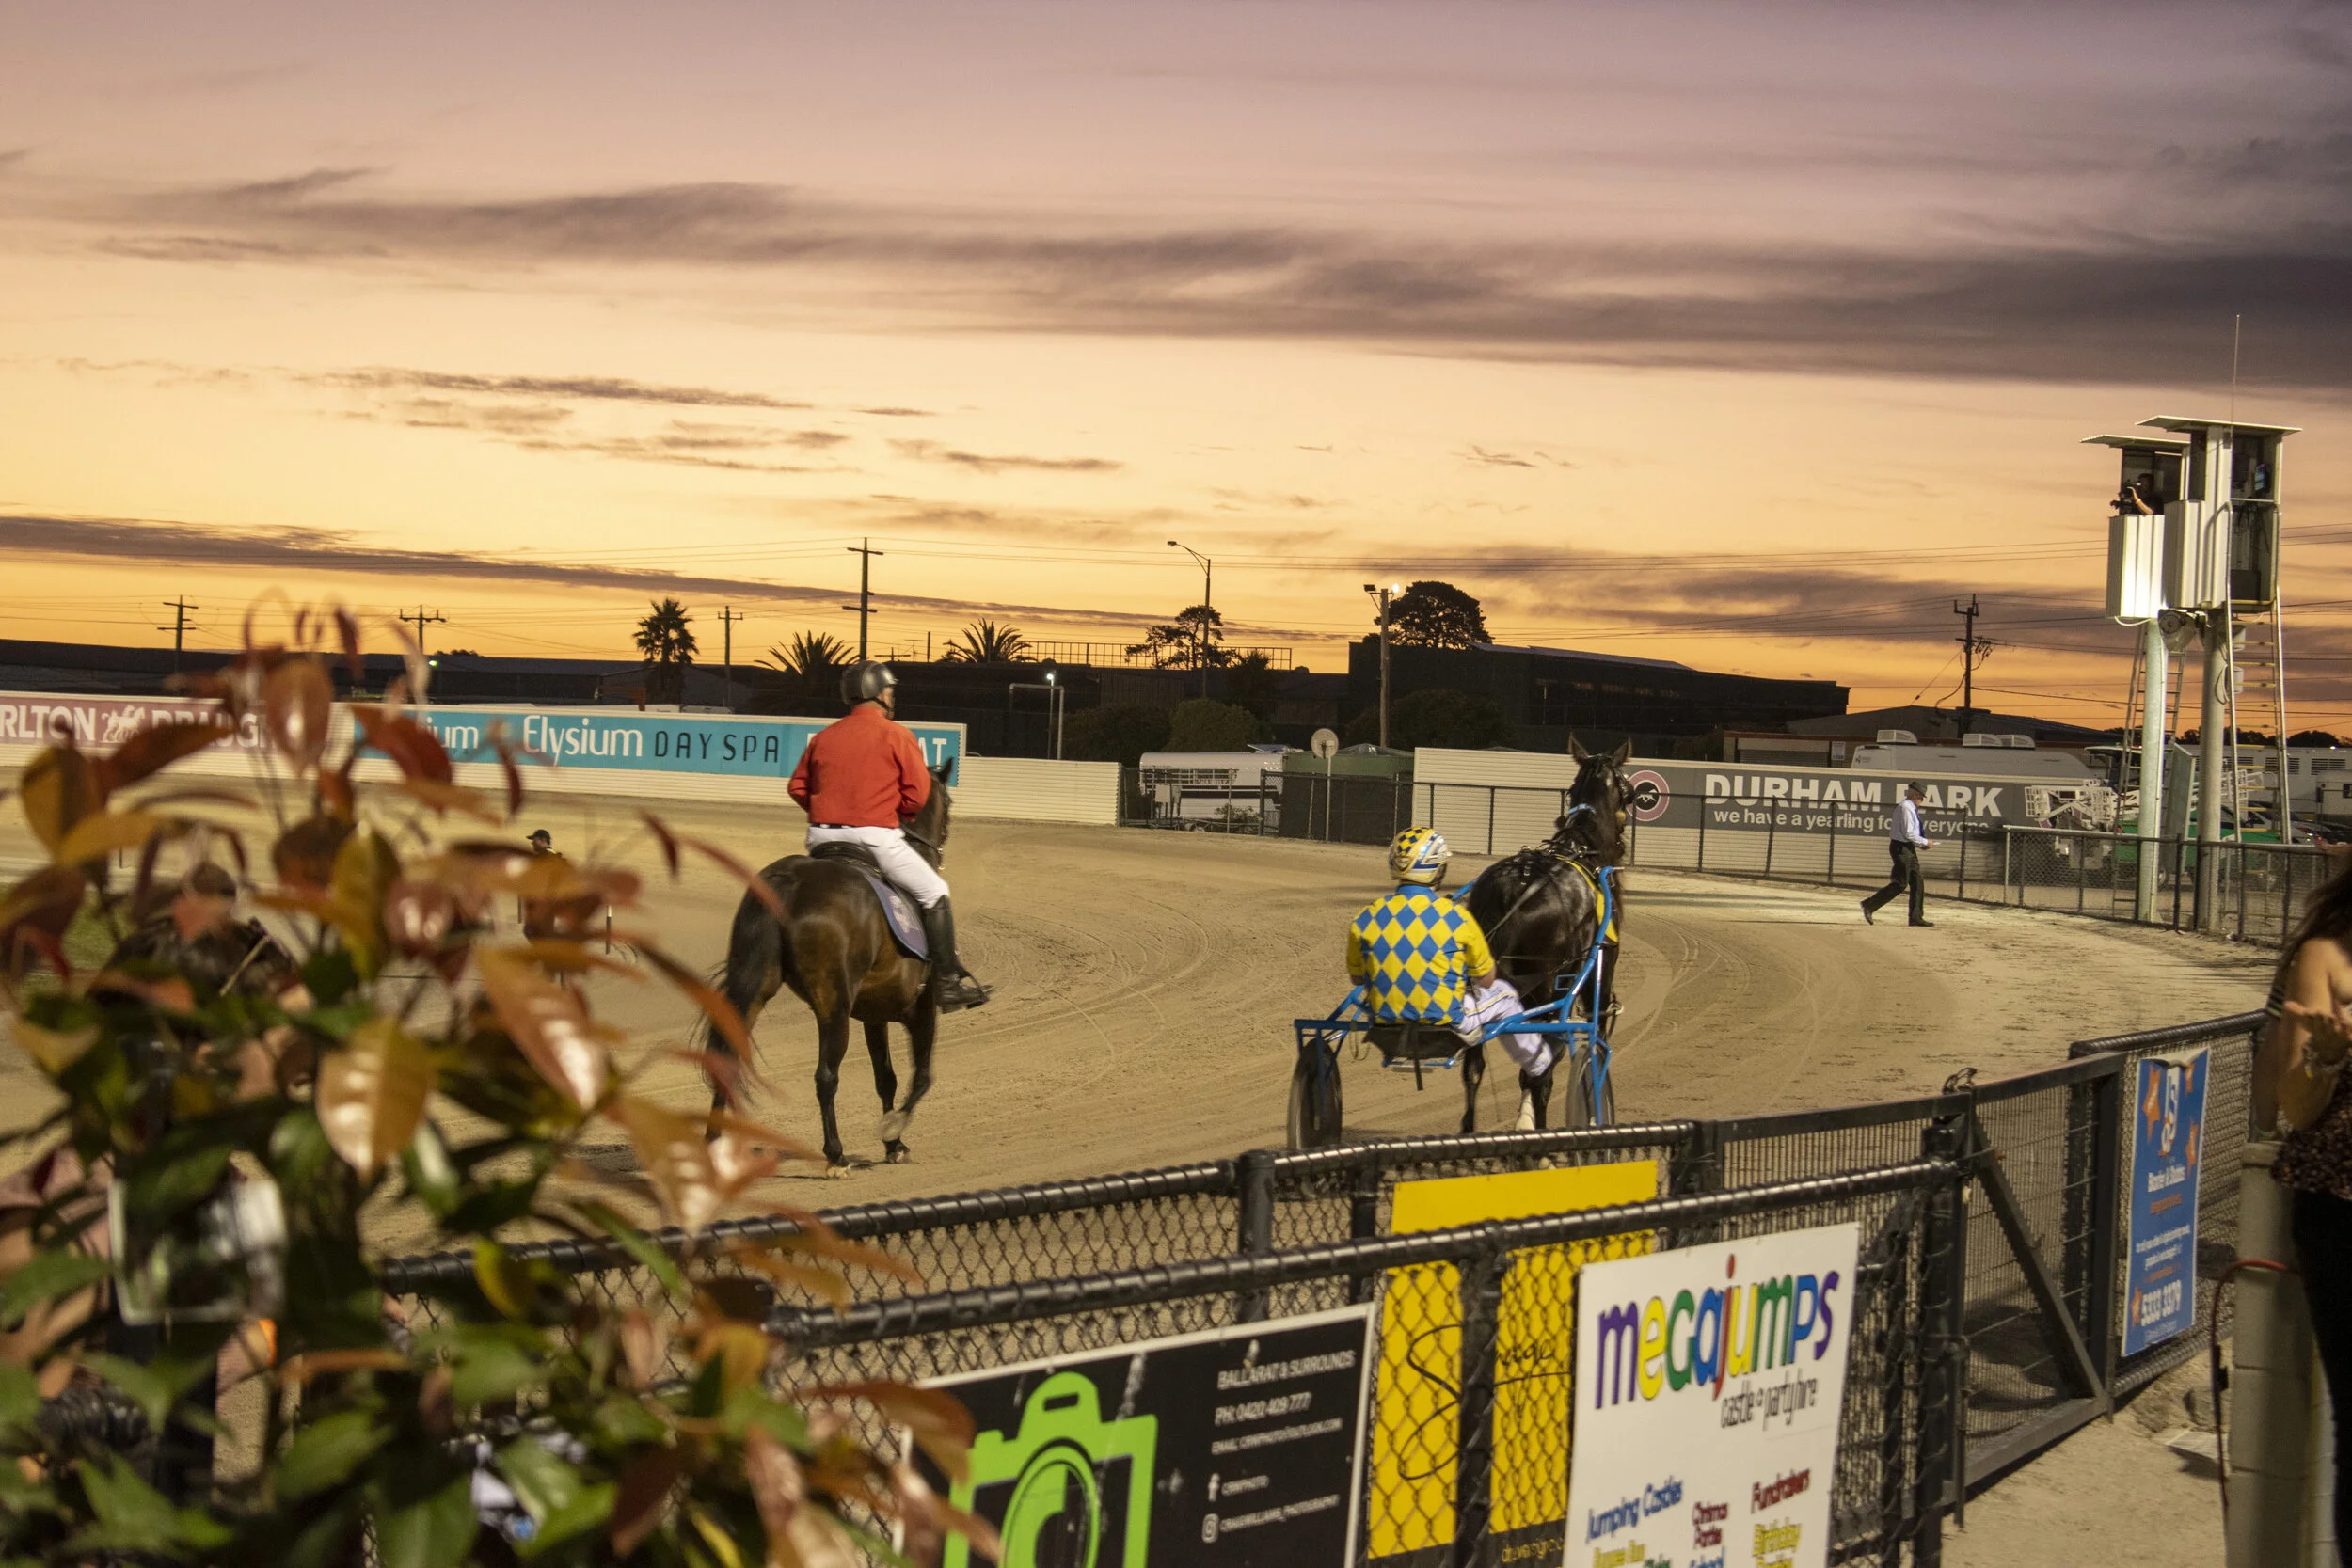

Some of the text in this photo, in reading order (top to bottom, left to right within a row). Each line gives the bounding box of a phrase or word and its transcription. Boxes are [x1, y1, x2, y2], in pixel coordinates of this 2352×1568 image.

[523, 715, 644, 768] Elysium
[1704, 773, 1882, 813] DURHAM
[1714, 810, 1740, 823] we
[1744, 809, 1787, 826] have
[1791, 814, 1802, 826] a
[1806, 813, 1874, 832] yearling
[1877, 815, 1893, 830] fo
[1216, 1362, 1279, 1390] BALLARAT
[1288, 1349, 1357, 1378] SURROUNDS
[1585, 1497, 1640, 1544] Jumping
